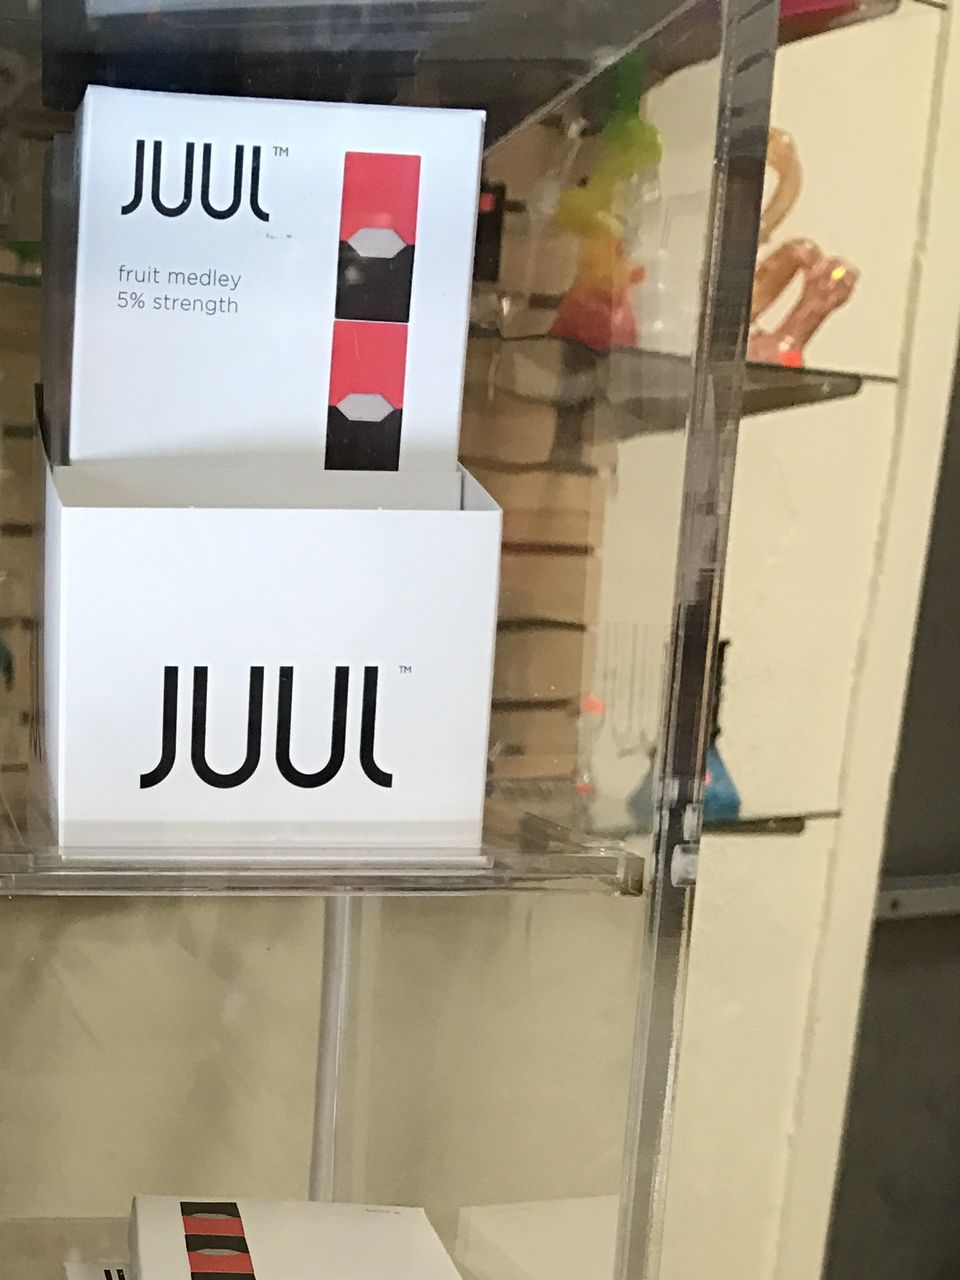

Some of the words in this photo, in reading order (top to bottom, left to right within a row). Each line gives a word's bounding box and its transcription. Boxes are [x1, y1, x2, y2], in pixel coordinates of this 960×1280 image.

[120, 139, 270, 223] JUUL
[117, 290, 146, 310] 5%
[152, 294, 238, 316] strength
[118, 264, 160, 284] fruit
[169, 268, 243, 290] medley
[139, 665, 393, 790] JUUL
